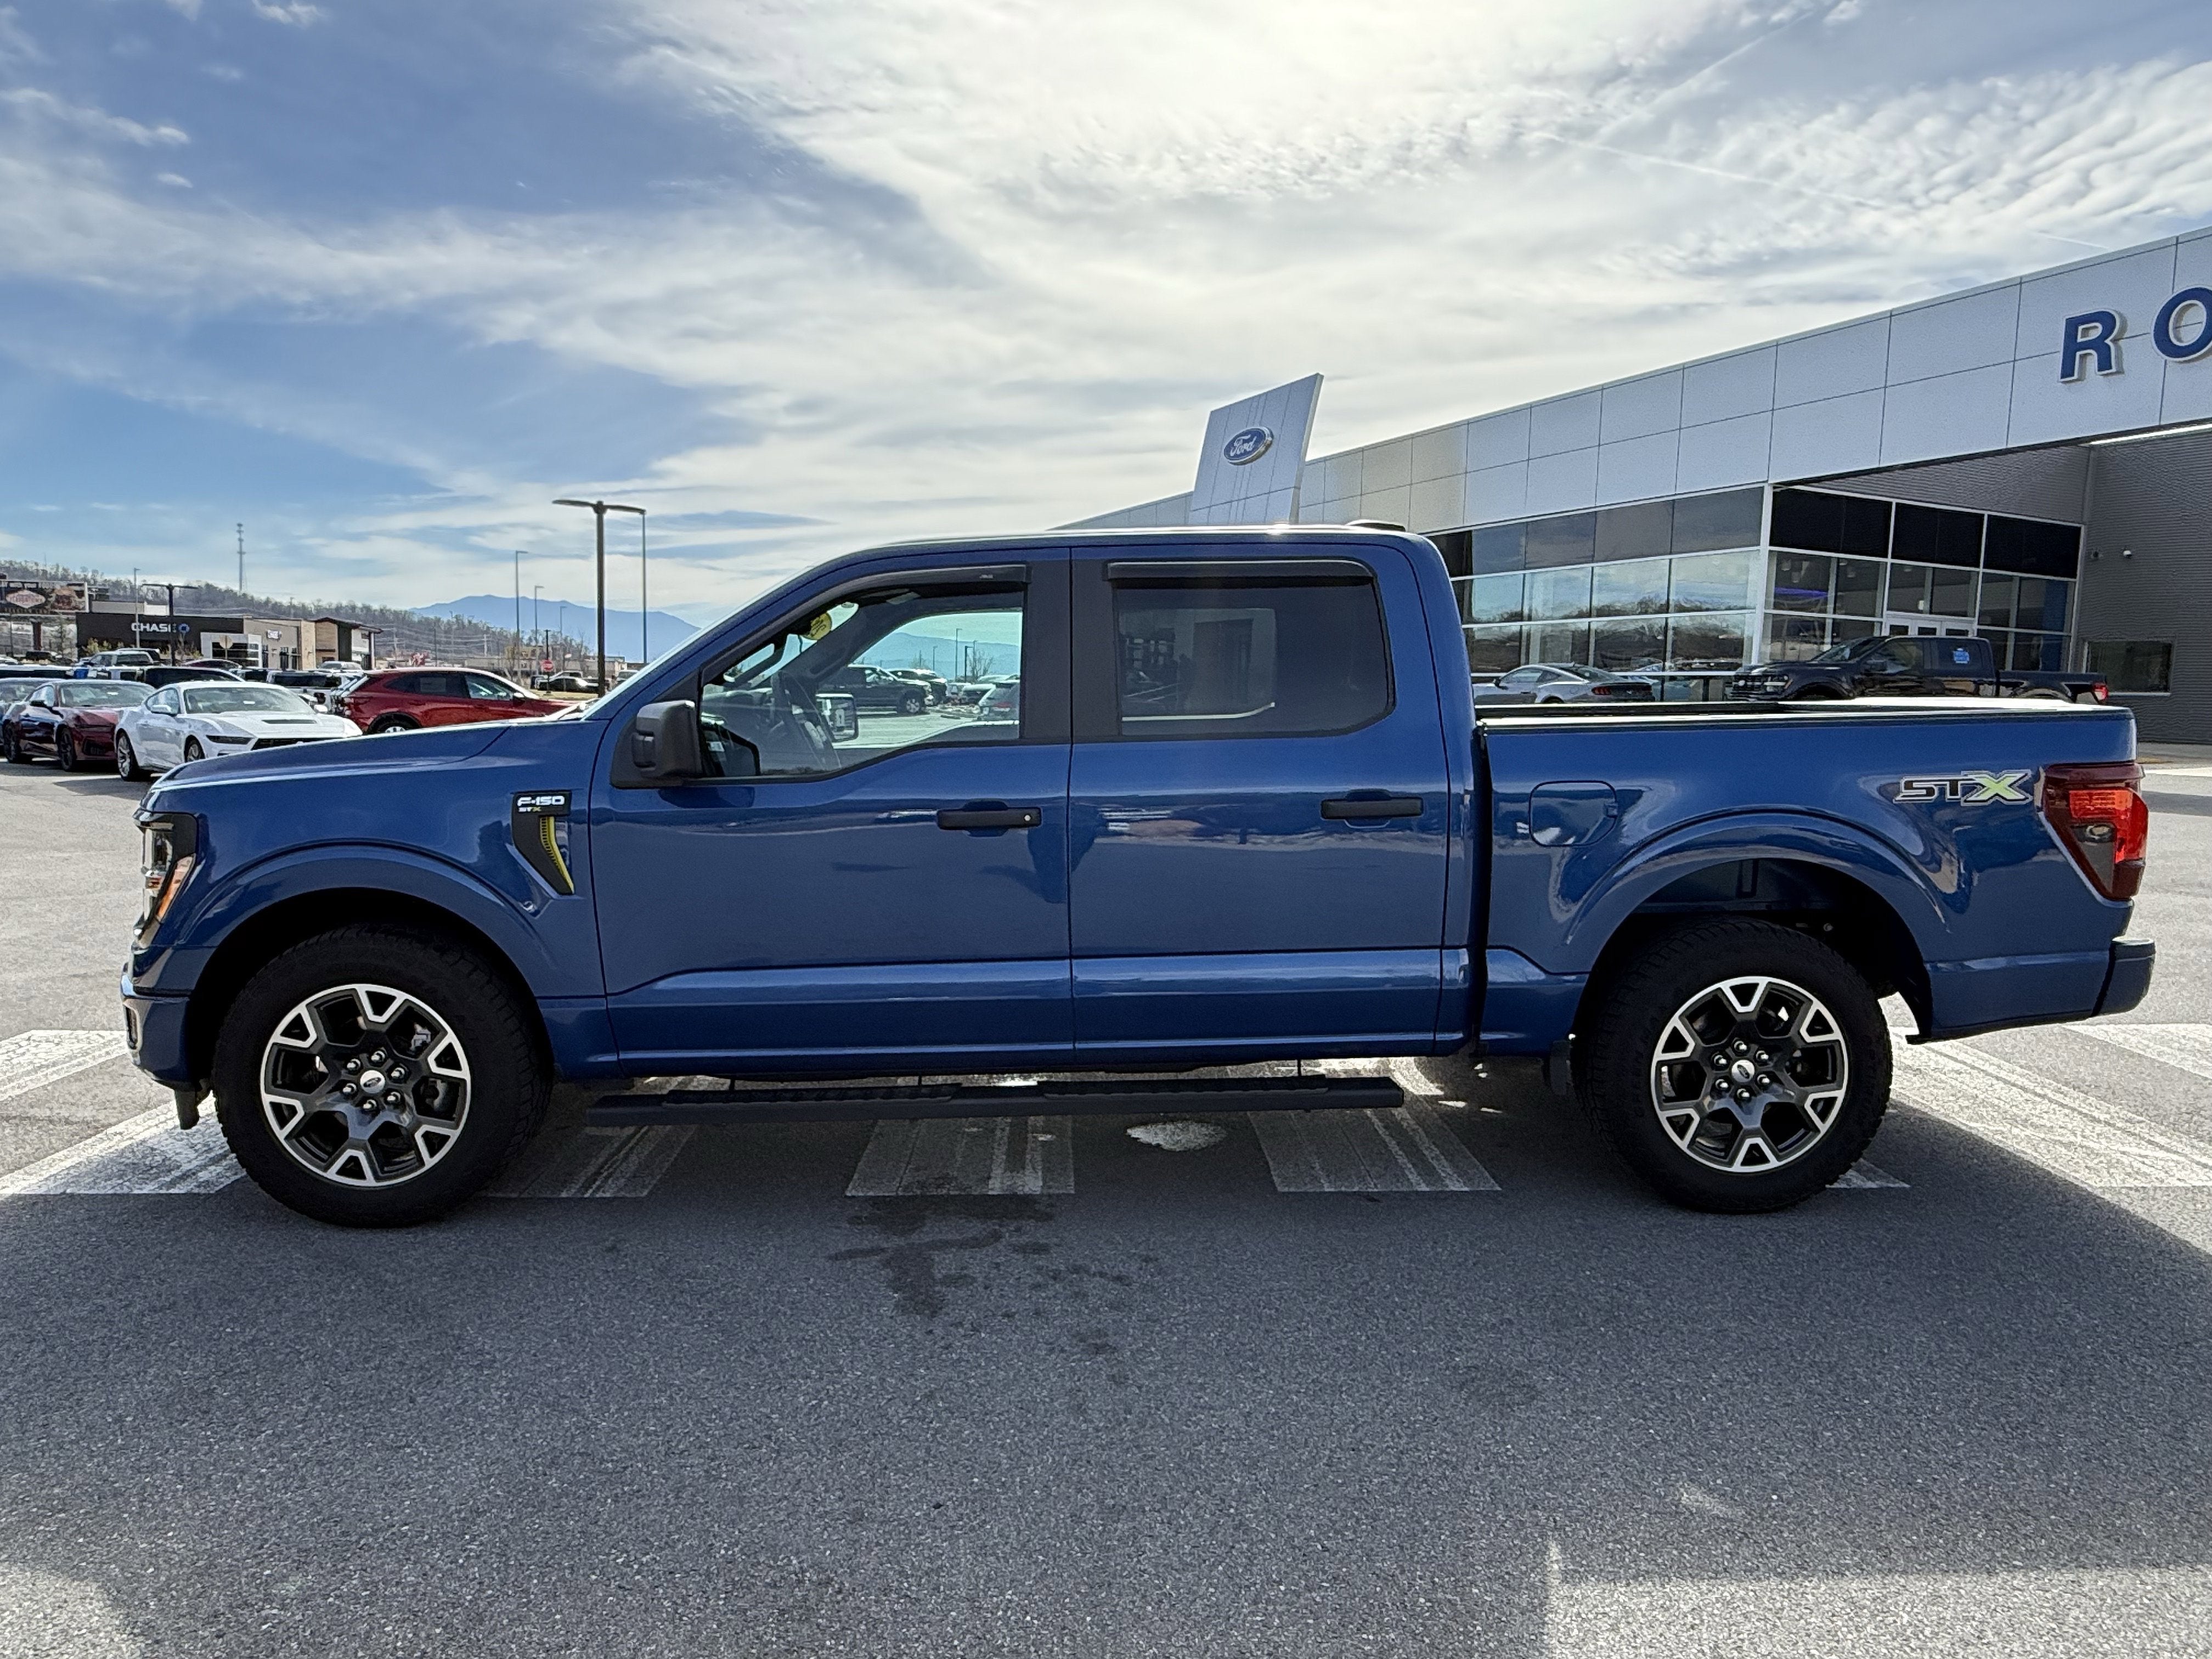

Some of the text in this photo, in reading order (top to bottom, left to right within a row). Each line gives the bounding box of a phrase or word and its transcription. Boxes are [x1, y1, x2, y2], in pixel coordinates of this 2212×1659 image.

[1230, 435, 1257, 456] Ford
[1893, 770, 2032, 806] STX
[517, 796, 565, 806] F-150
